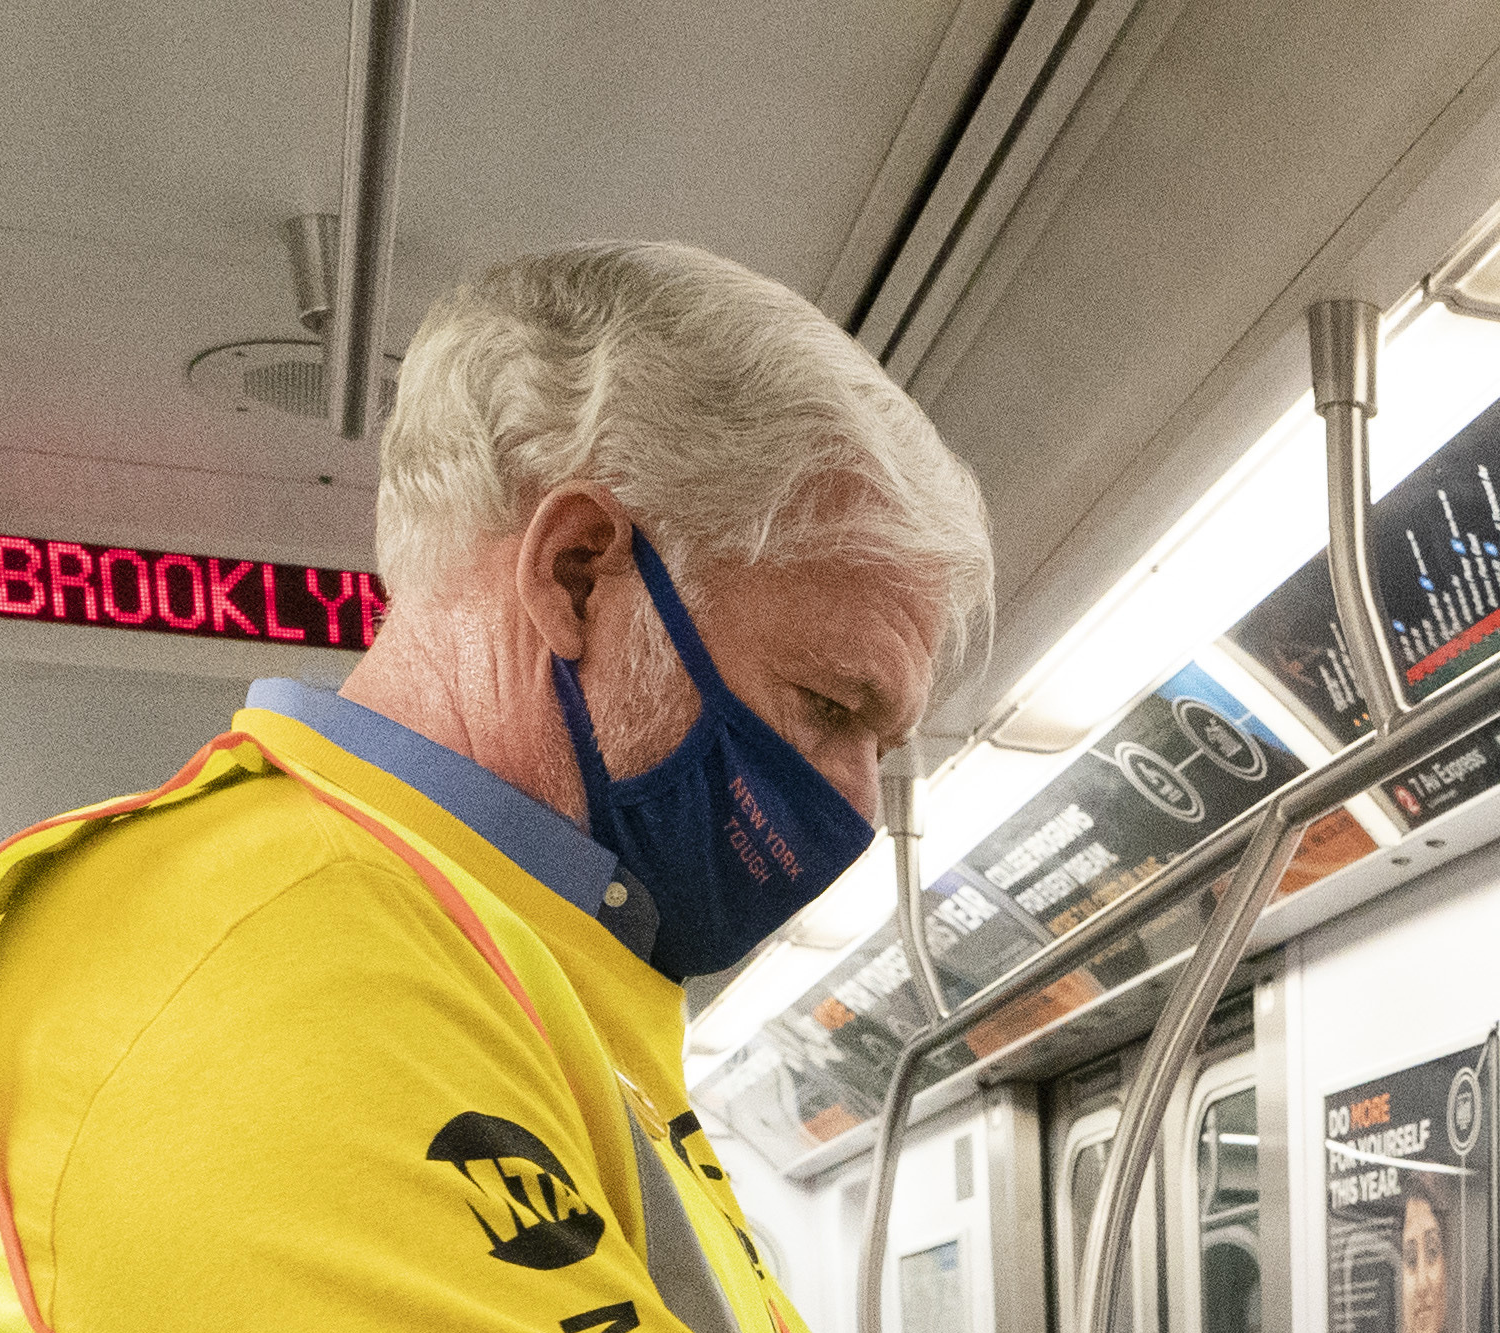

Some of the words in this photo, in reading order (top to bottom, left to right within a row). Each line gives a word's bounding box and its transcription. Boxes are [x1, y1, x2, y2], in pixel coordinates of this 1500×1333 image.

[724, 816, 772, 886] TOUGH
[728, 776, 768, 830] NEW
[765, 827, 804, 881] YORK
[1329, 1107, 1349, 1137] DO
[443, 1133, 604, 1253] MTA
